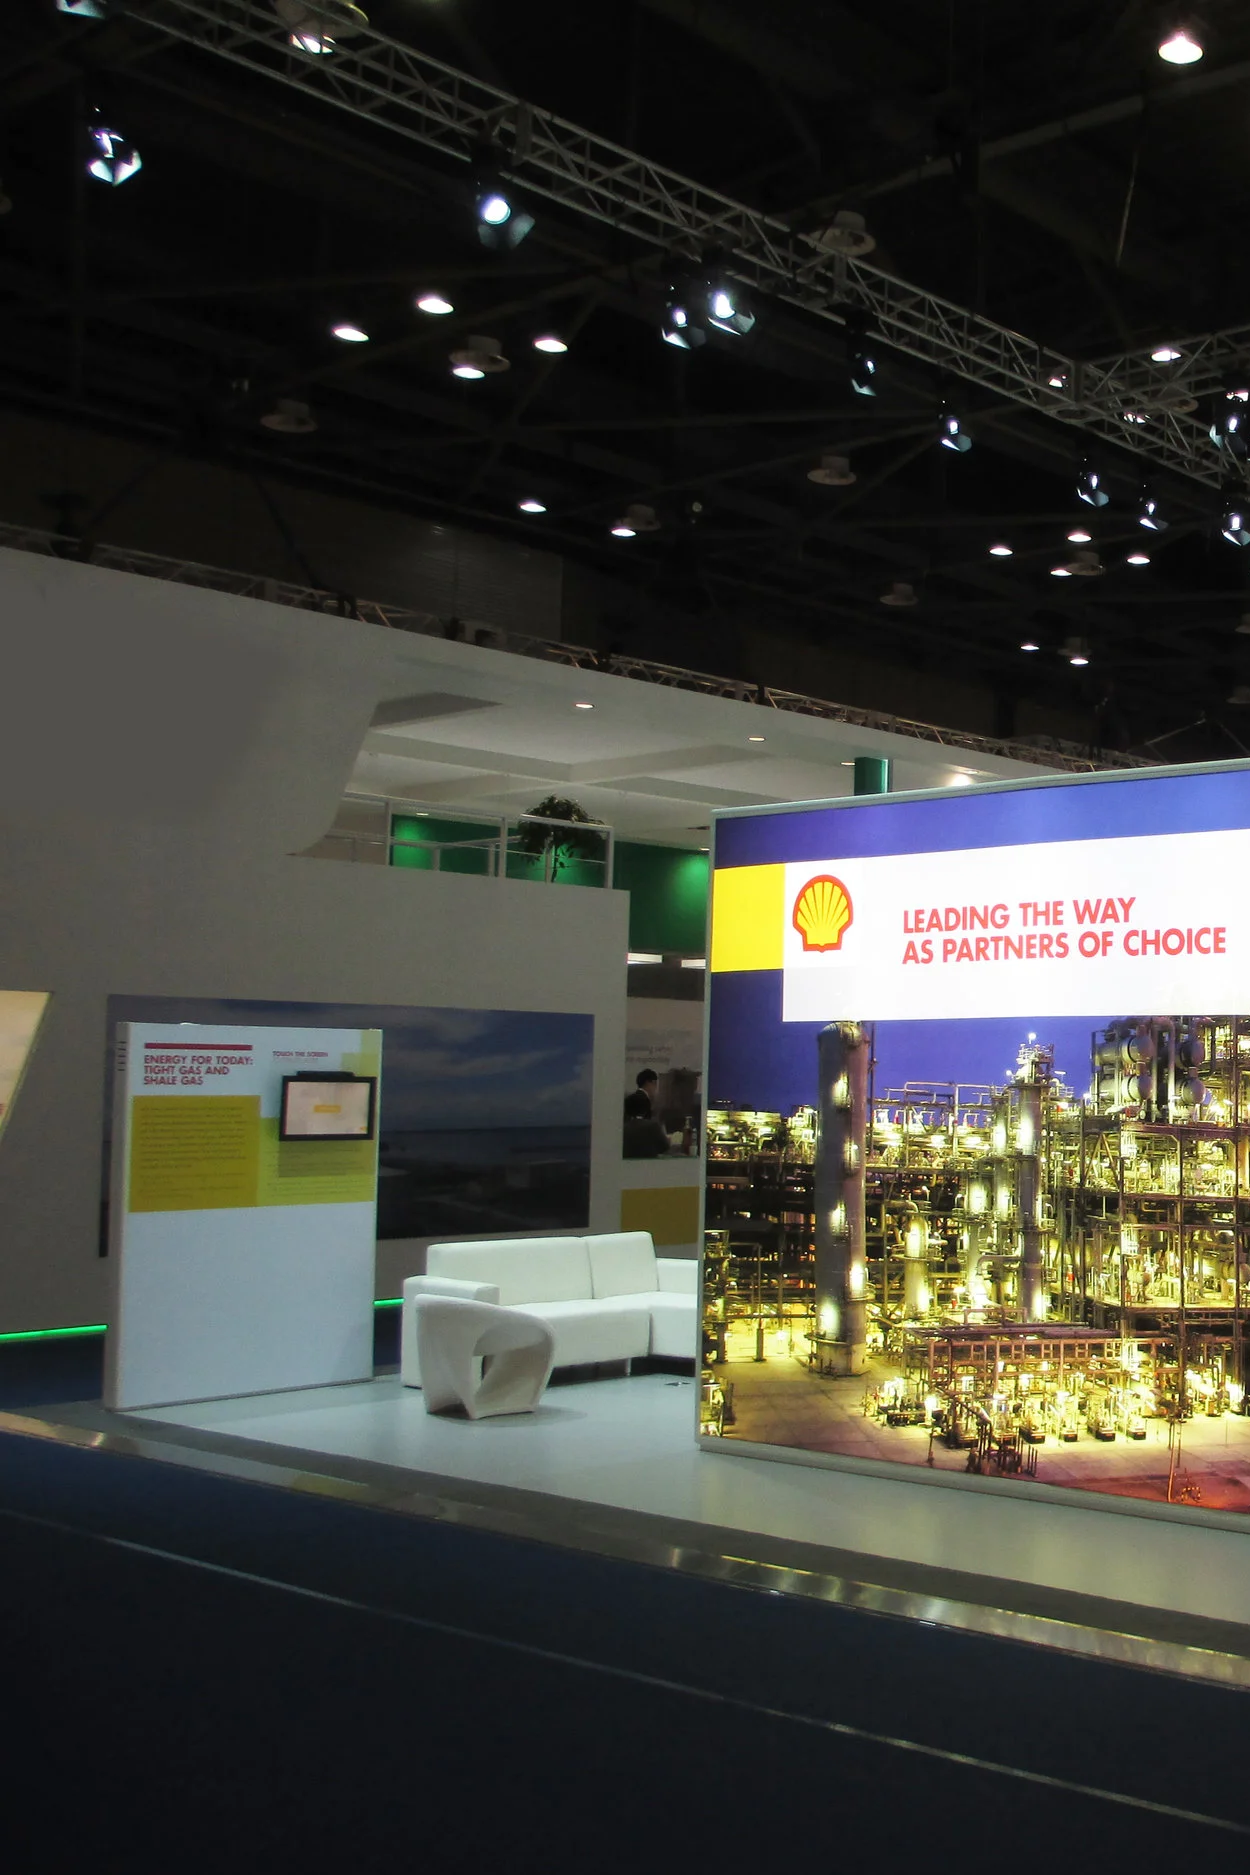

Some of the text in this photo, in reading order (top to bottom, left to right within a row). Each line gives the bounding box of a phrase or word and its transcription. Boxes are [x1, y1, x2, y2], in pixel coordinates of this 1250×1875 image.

[903, 897, 1136, 934] LEADING THE WAY
[902, 927, 1227, 964] AS PARTNERS OF CHOICE
[144, 1055, 253, 1065] ENERGY FOR TODAY:
[144, 1065, 230, 1075] TIGHT GAS AND
[144, 1076, 204, 1086] SHALE GAS
